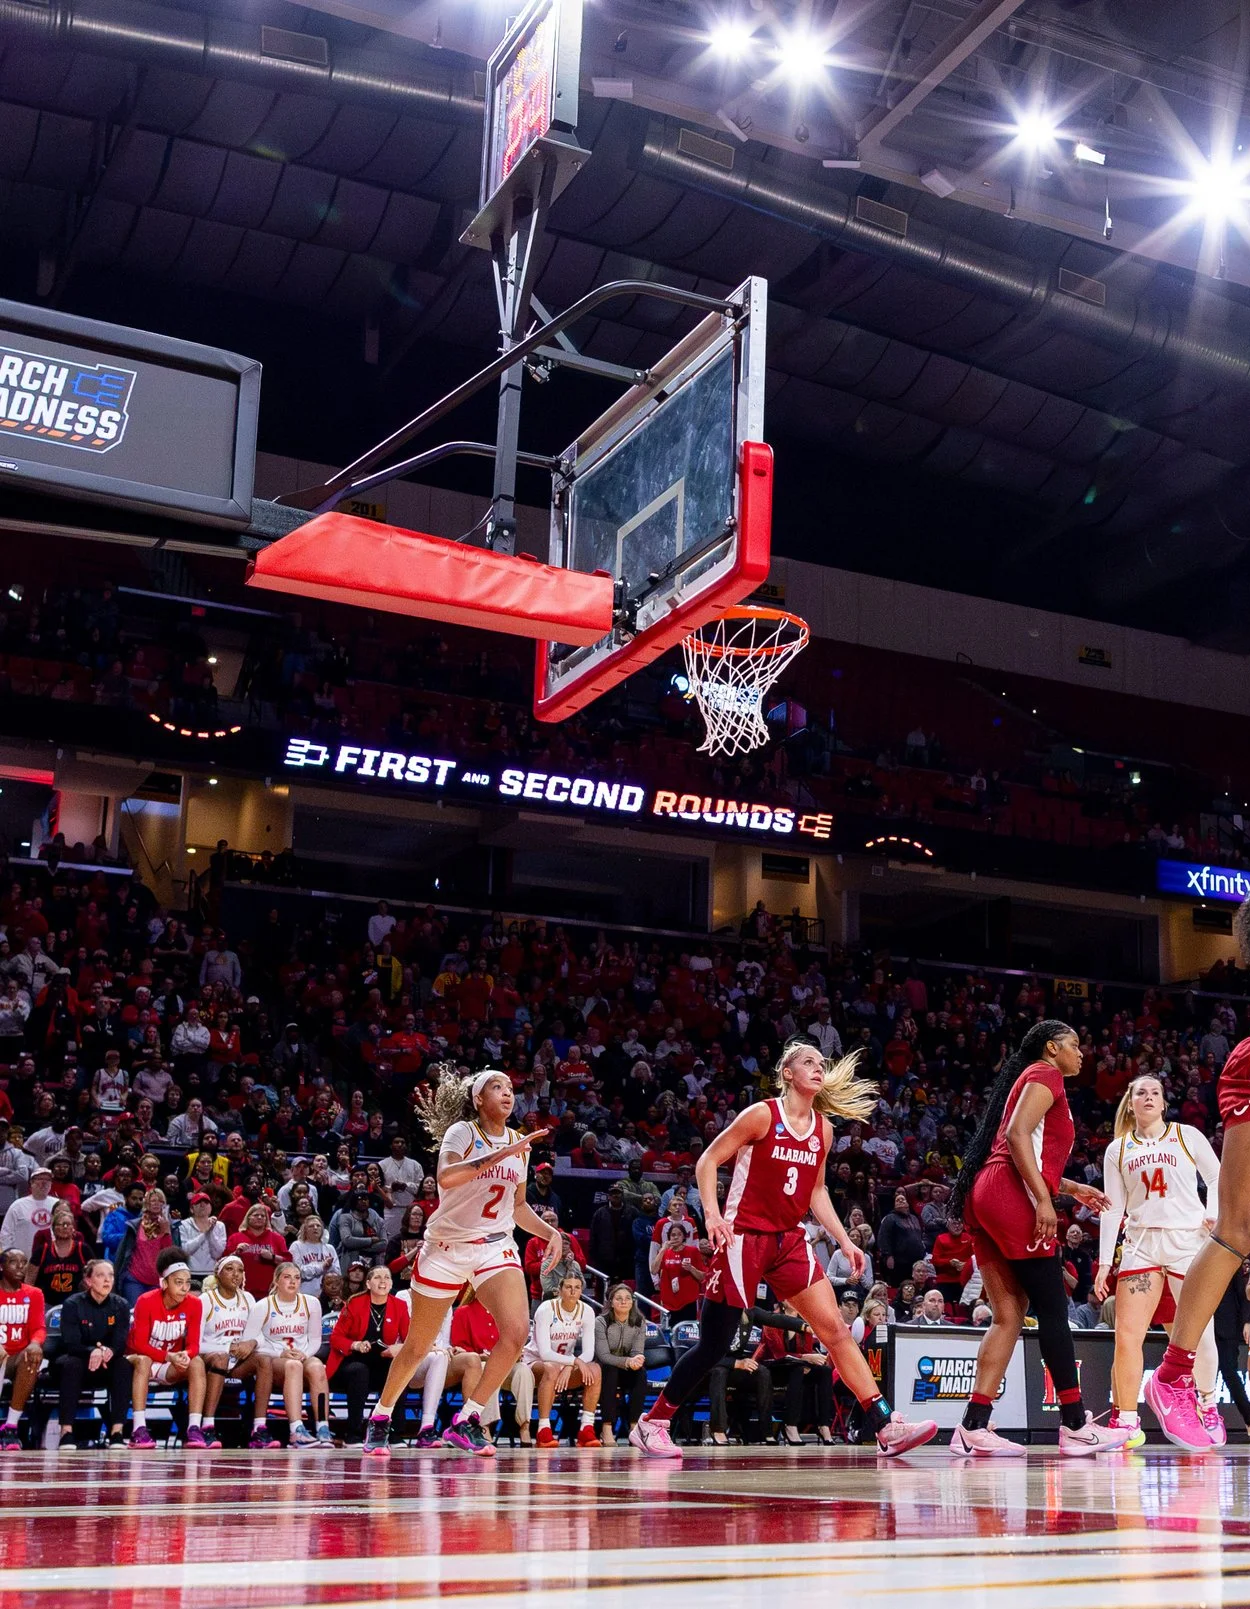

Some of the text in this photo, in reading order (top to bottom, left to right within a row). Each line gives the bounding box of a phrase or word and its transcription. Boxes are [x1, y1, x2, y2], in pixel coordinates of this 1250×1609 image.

[0, 355, 69, 396] RCH
[0, 387, 122, 440] DNESS
[351, 501, 377, 516] 201
[335, 746, 796, 833] FIRST AND SECOND ROUNDS
[771, 1145, 817, 1167] ALABAMA
[1128, 1153, 1177, 1174] MARYLAND
[783, 1166, 799, 1196] 3
[1141, 1167, 1168, 1200] 14
[481, 1184, 506, 1219] 2
[503, 1249, 514, 1259] M
[51, 1273, 73, 1292] 42
[0, 1304, 30, 1325] OUBT
[11, 1328, 22, 1340] M
[153, 1320, 187, 1342] DOUBT
[269, 1325, 305, 1336] MARYLAND
